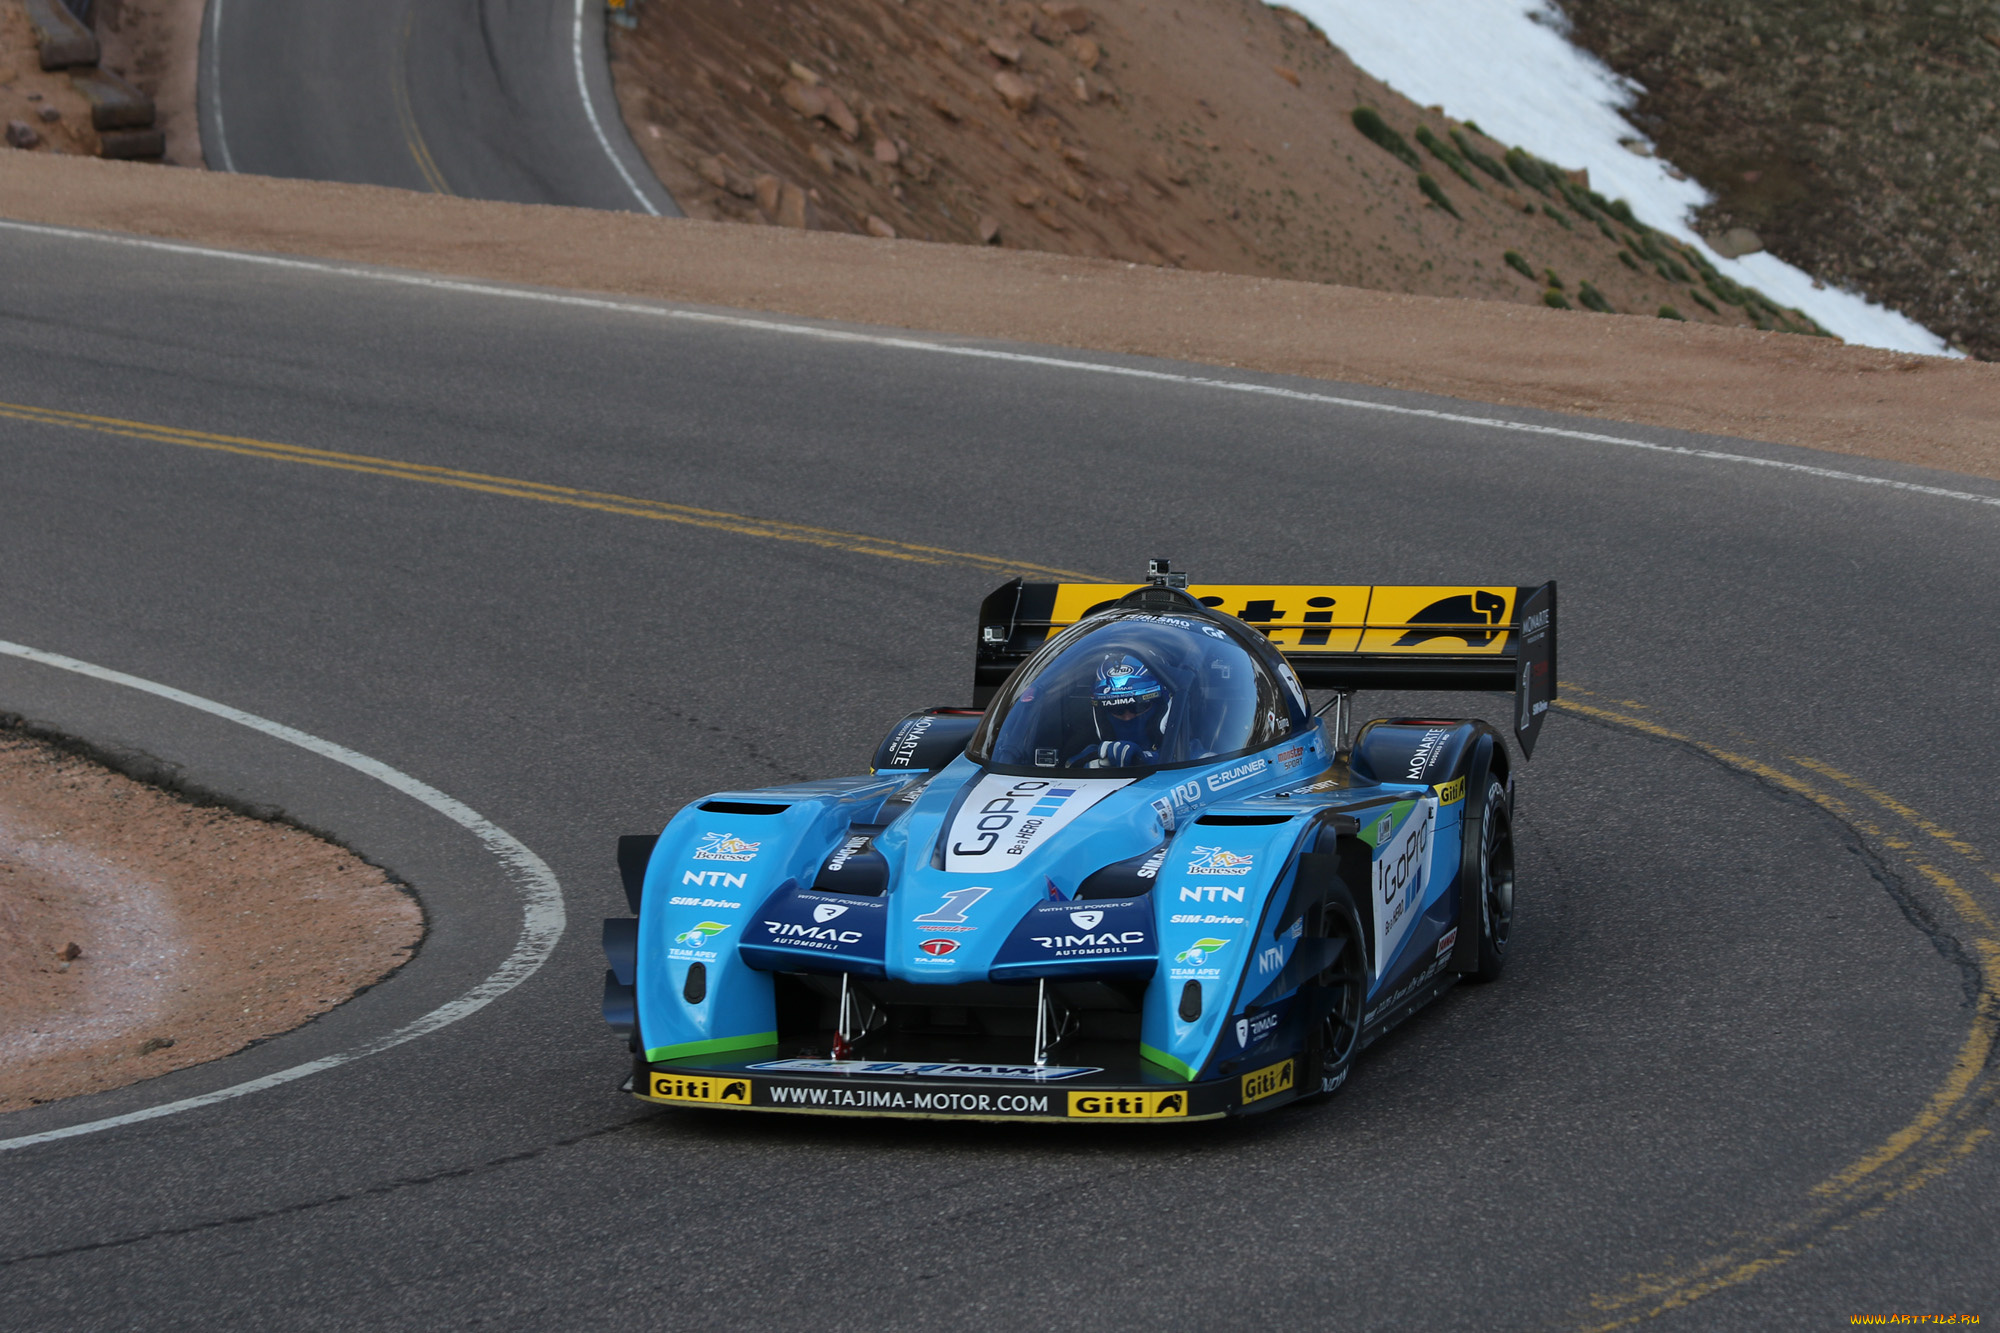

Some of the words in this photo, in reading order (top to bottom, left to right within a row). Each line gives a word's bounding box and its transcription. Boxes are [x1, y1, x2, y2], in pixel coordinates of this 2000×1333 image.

[1102, 697, 1136, 707] TAJIMA
[894, 716, 937, 767] MONARTE
[1406, 728, 1443, 779] MONARTE
[1284, 757, 1303, 770] SPORT
[1441, 784, 1458, 802] Giti
[694, 850, 754, 862] Benesse
[1006, 844, 1026, 855] Be
[1188, 865, 1248, 875] Benesse
[1384, 818, 1428, 905] GoPro
[682, 870, 748, 889] NTN
[669, 896, 741, 909] SIM-Drive
[797, 893, 820, 901] WITH
[821, 895, 837, 903] THE
[838, 898, 867, 908] POWER
[1179, 886, 1246, 903] NTN
[912, 886, 993, 923] 1
[1084, 903, 1119, 911] POWER
[1170, 914, 1245, 925] SIM-Drive
[763, 920, 863, 944] RIMAC
[1030, 931, 1144, 949] RIMAC
[772, 937, 839, 950] AUTOMOBILI
[1055, 946, 1128, 957] AUTOMOBILI
[669, 948, 694, 957] TEAM
[694, 950, 718, 959] APEV
[1259, 945, 1284, 975] NTN
[1170, 968, 1196, 976] TEAM
[1196, 968, 1221, 976] APEV
[655, 1078, 710, 1099] Giti
[1245, 1071, 1276, 1099] Giti
[769, 1086, 1049, 1113] WWW.TAJIMA-MOTOR.COM
[1075, 1096, 1144, 1114] Giti
